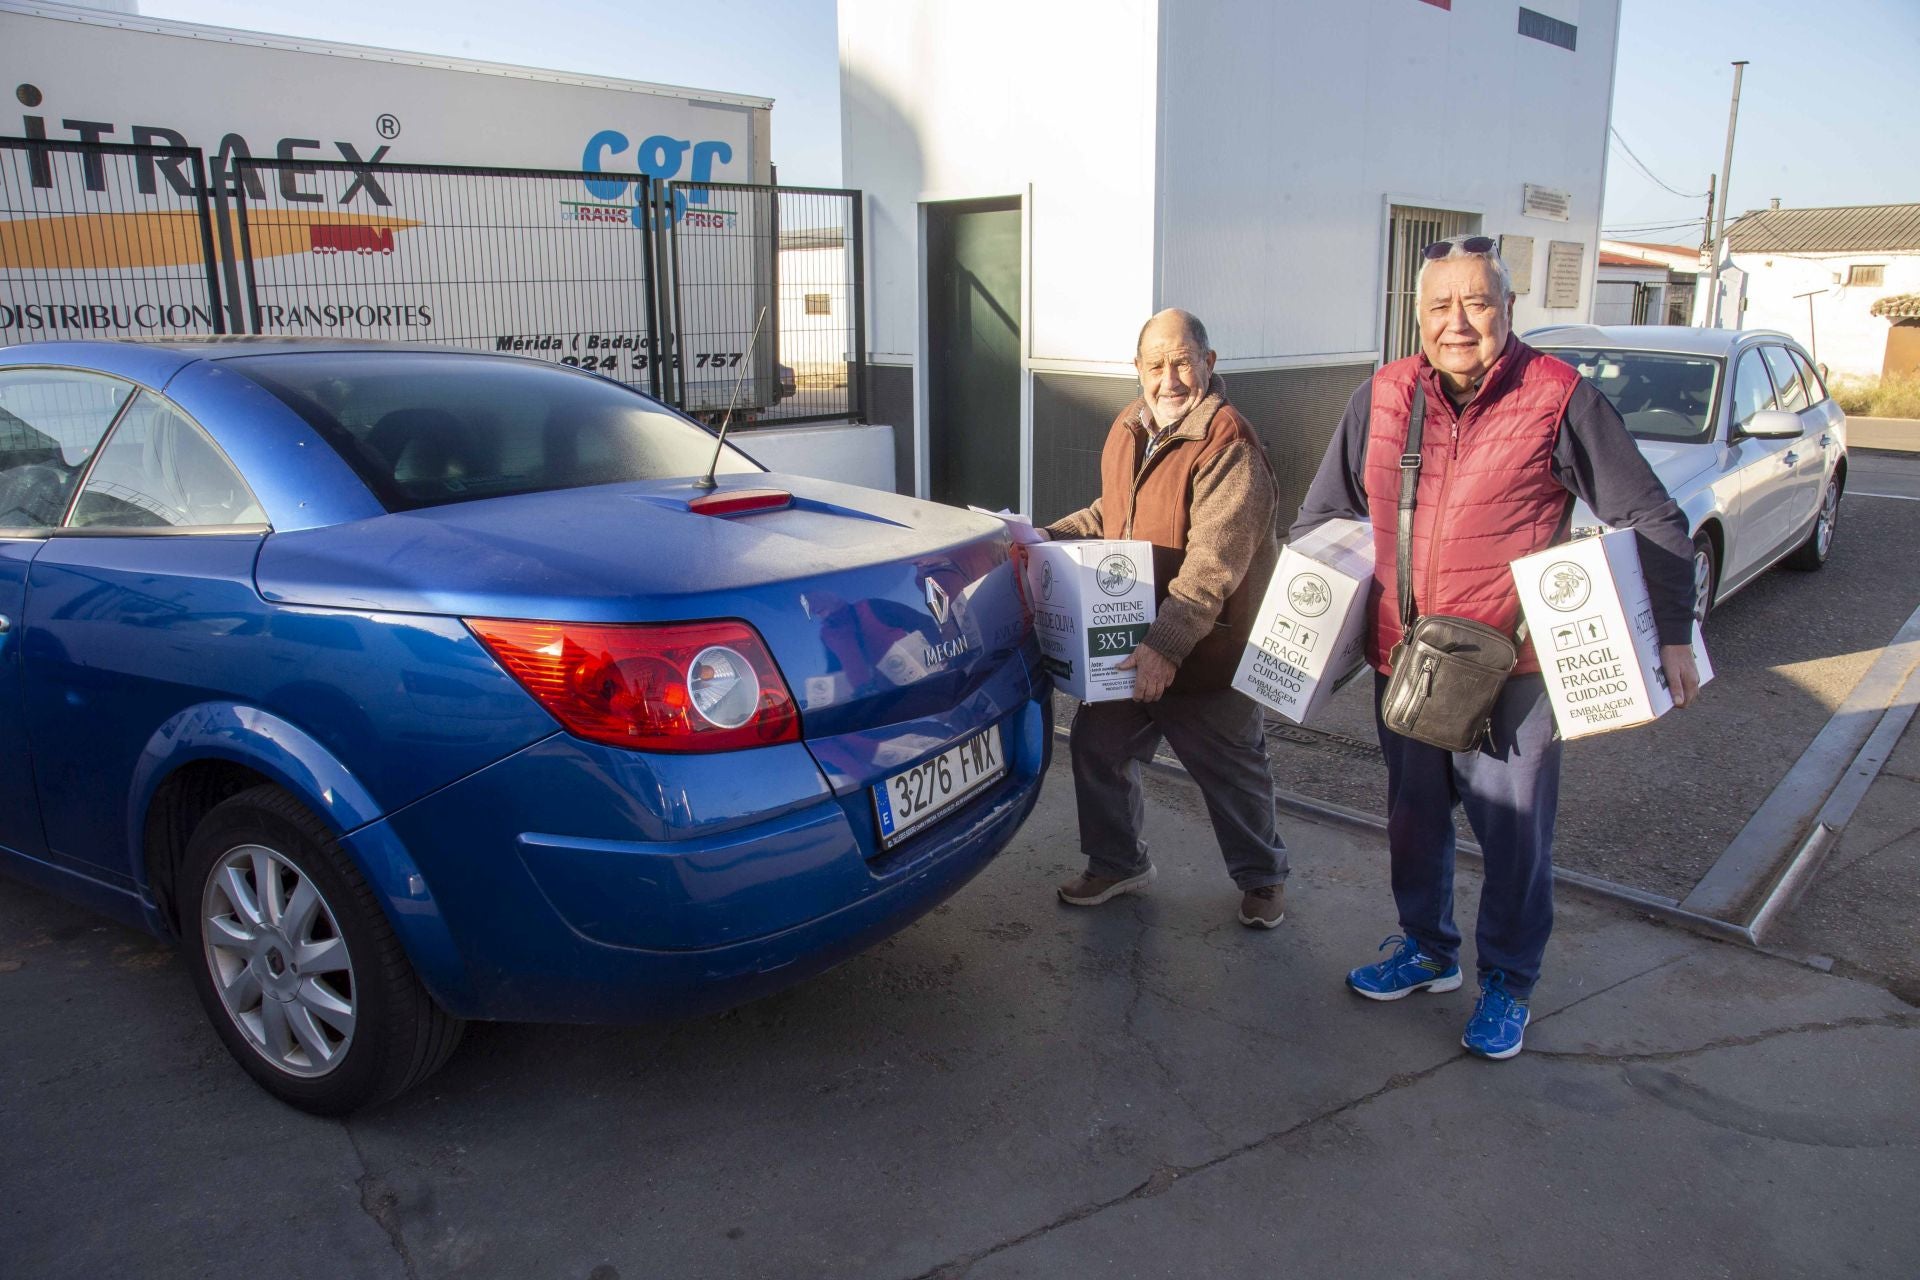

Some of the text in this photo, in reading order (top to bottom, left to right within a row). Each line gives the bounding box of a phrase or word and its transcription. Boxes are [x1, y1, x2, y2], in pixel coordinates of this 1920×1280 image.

[582, 130, 733, 232] cgr
[496, 334, 563, 351] Mérida
[587, 334, 660, 351] Badajo
[696, 352, 743, 369] 757
[1092, 600, 1144, 614] CONTIENE
[1093, 611, 1145, 626] CONTAINS
[1097, 631, 1127, 651] 3X5
[1262, 636, 1309, 670] FRAGIL
[1556, 647, 1619, 673] FRAGIL
[1256, 650, 1307, 683] FRAGILE
[1561, 663, 1624, 690] FRAGILE
[1252, 663, 1301, 693] CUIDADO
[1247, 674, 1297, 705] EMBALAGEM
[1256, 686, 1282, 706] FRAGIL
[1566, 680, 1628, 703] CUIDADO
[1569, 697, 1634, 718] EMBALAGEM
[1586, 709, 1623, 724] FRAGIL
[895, 754, 953, 818] 3276
[958, 728, 996, 784] FWX
[882, 811, 891, 826] E
